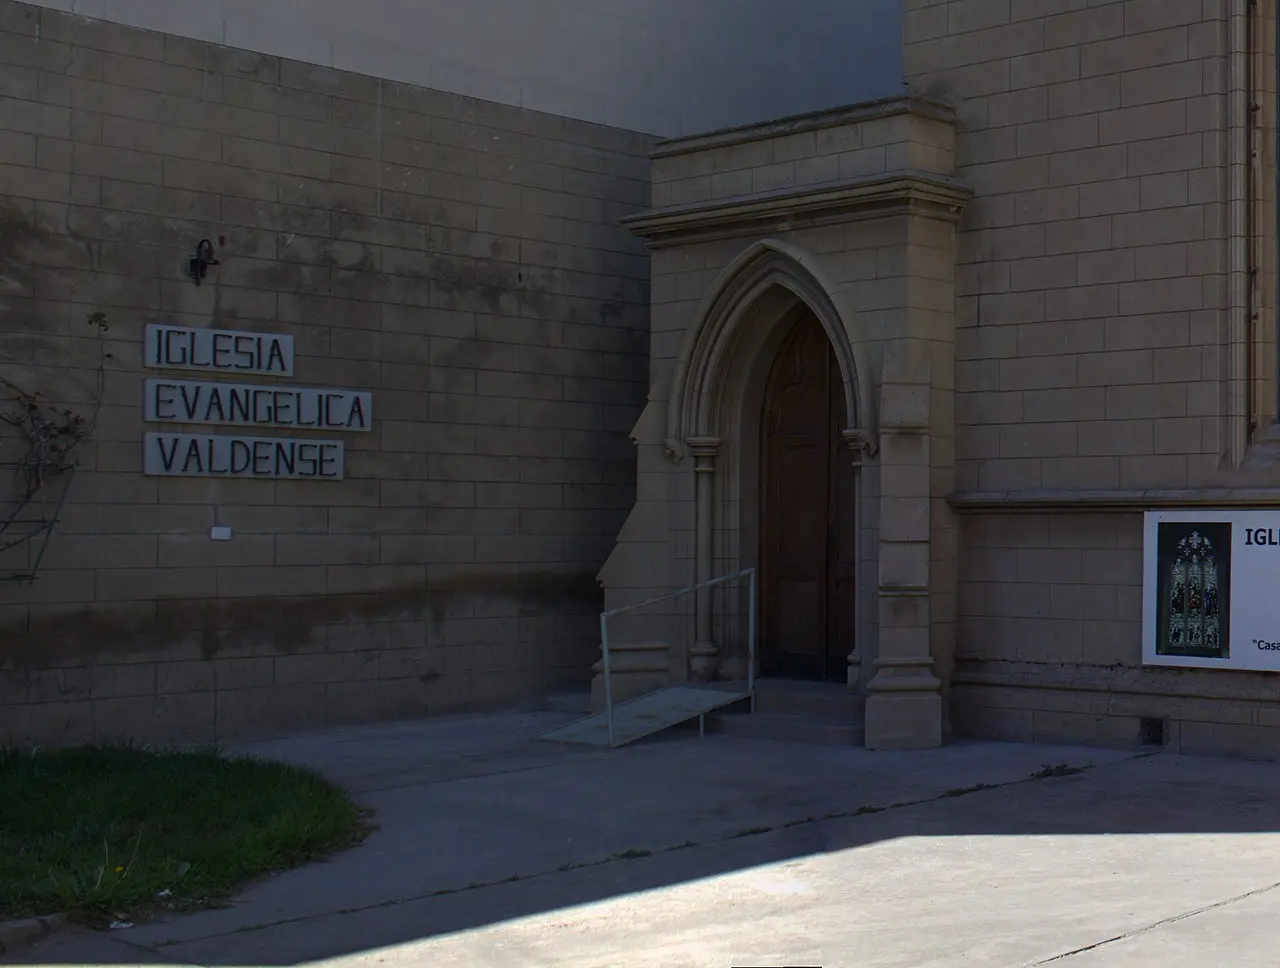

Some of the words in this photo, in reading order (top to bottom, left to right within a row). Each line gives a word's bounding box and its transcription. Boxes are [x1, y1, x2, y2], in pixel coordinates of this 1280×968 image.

[155, 329, 287, 371] IGLESIA
[155, 384, 364, 427] EVANGELICA
[157, 437, 337, 476] VALDENSE
